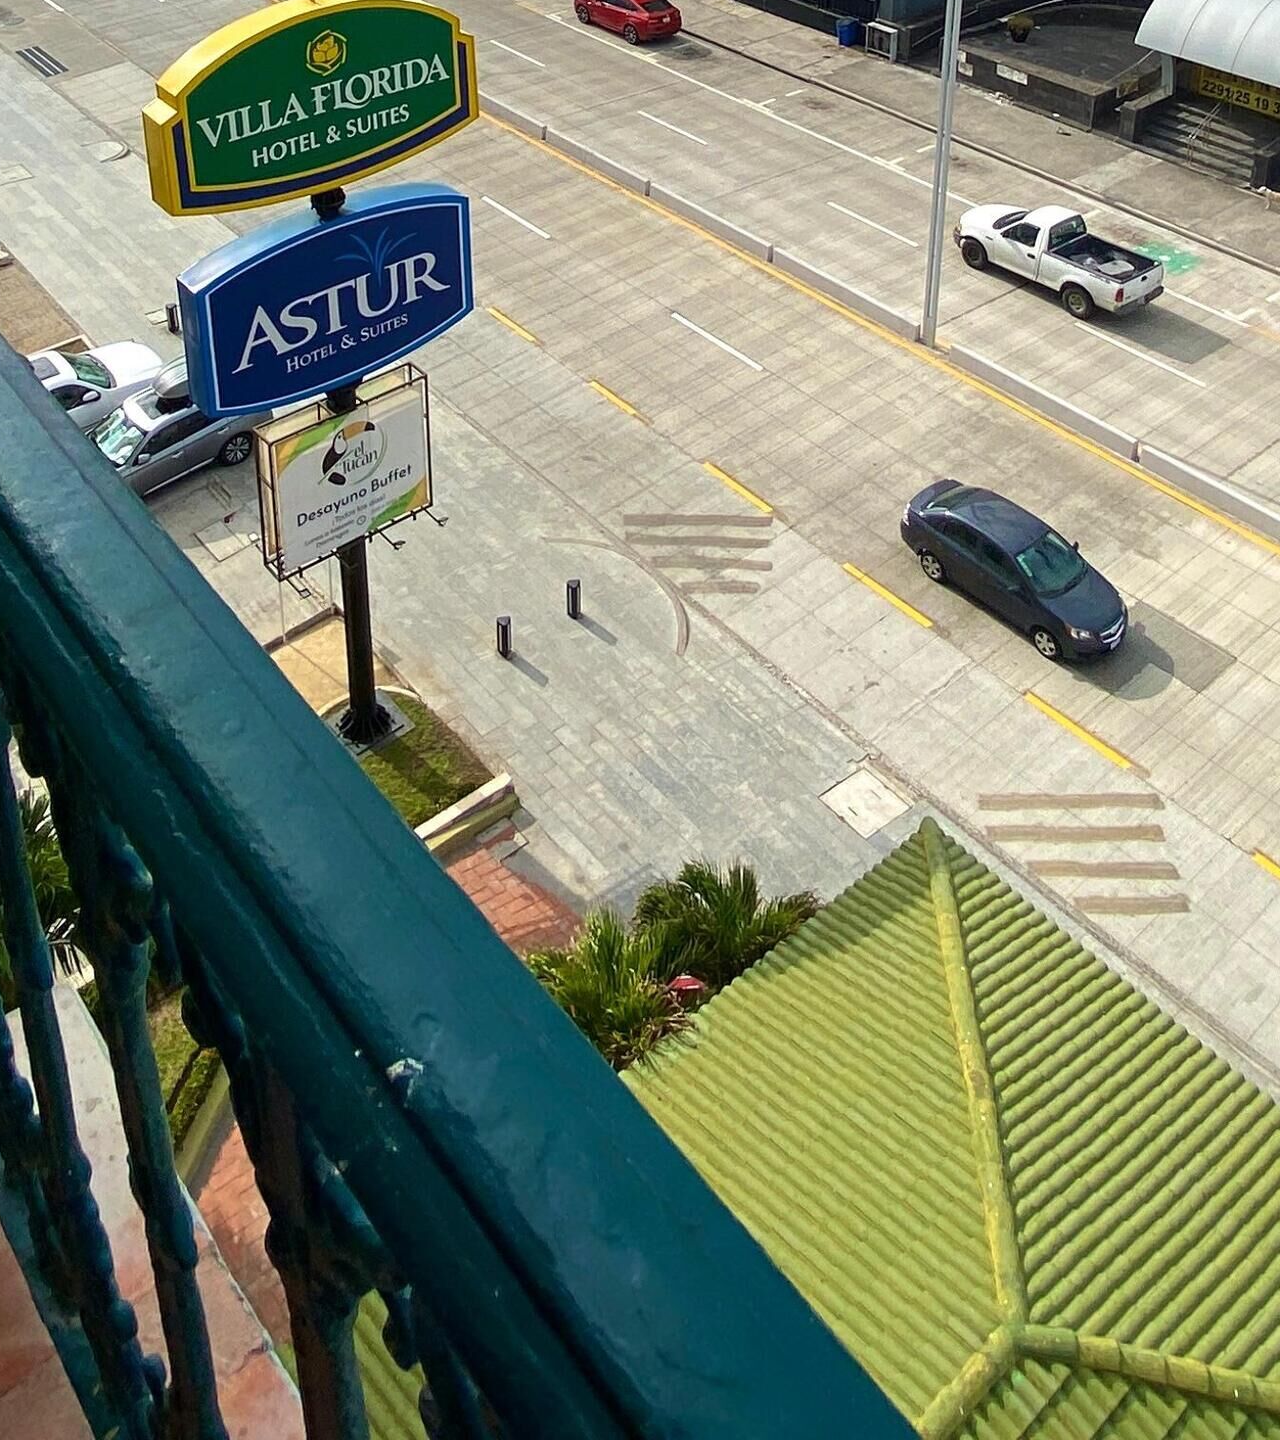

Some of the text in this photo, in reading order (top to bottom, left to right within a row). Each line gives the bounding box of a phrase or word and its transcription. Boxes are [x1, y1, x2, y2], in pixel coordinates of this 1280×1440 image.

[196, 53, 450, 148] VILLA FLORIDA
[1255, 98, 1269, 111] 19
[252, 104, 410, 167] HOTEL & SUITES
[231, 252, 451, 374] ASTUR
[341, 334, 357, 349] &
[354, 440, 365, 458] el
[296, 488, 368, 527] Desayuno
[370, 464, 412, 493] Buffet
